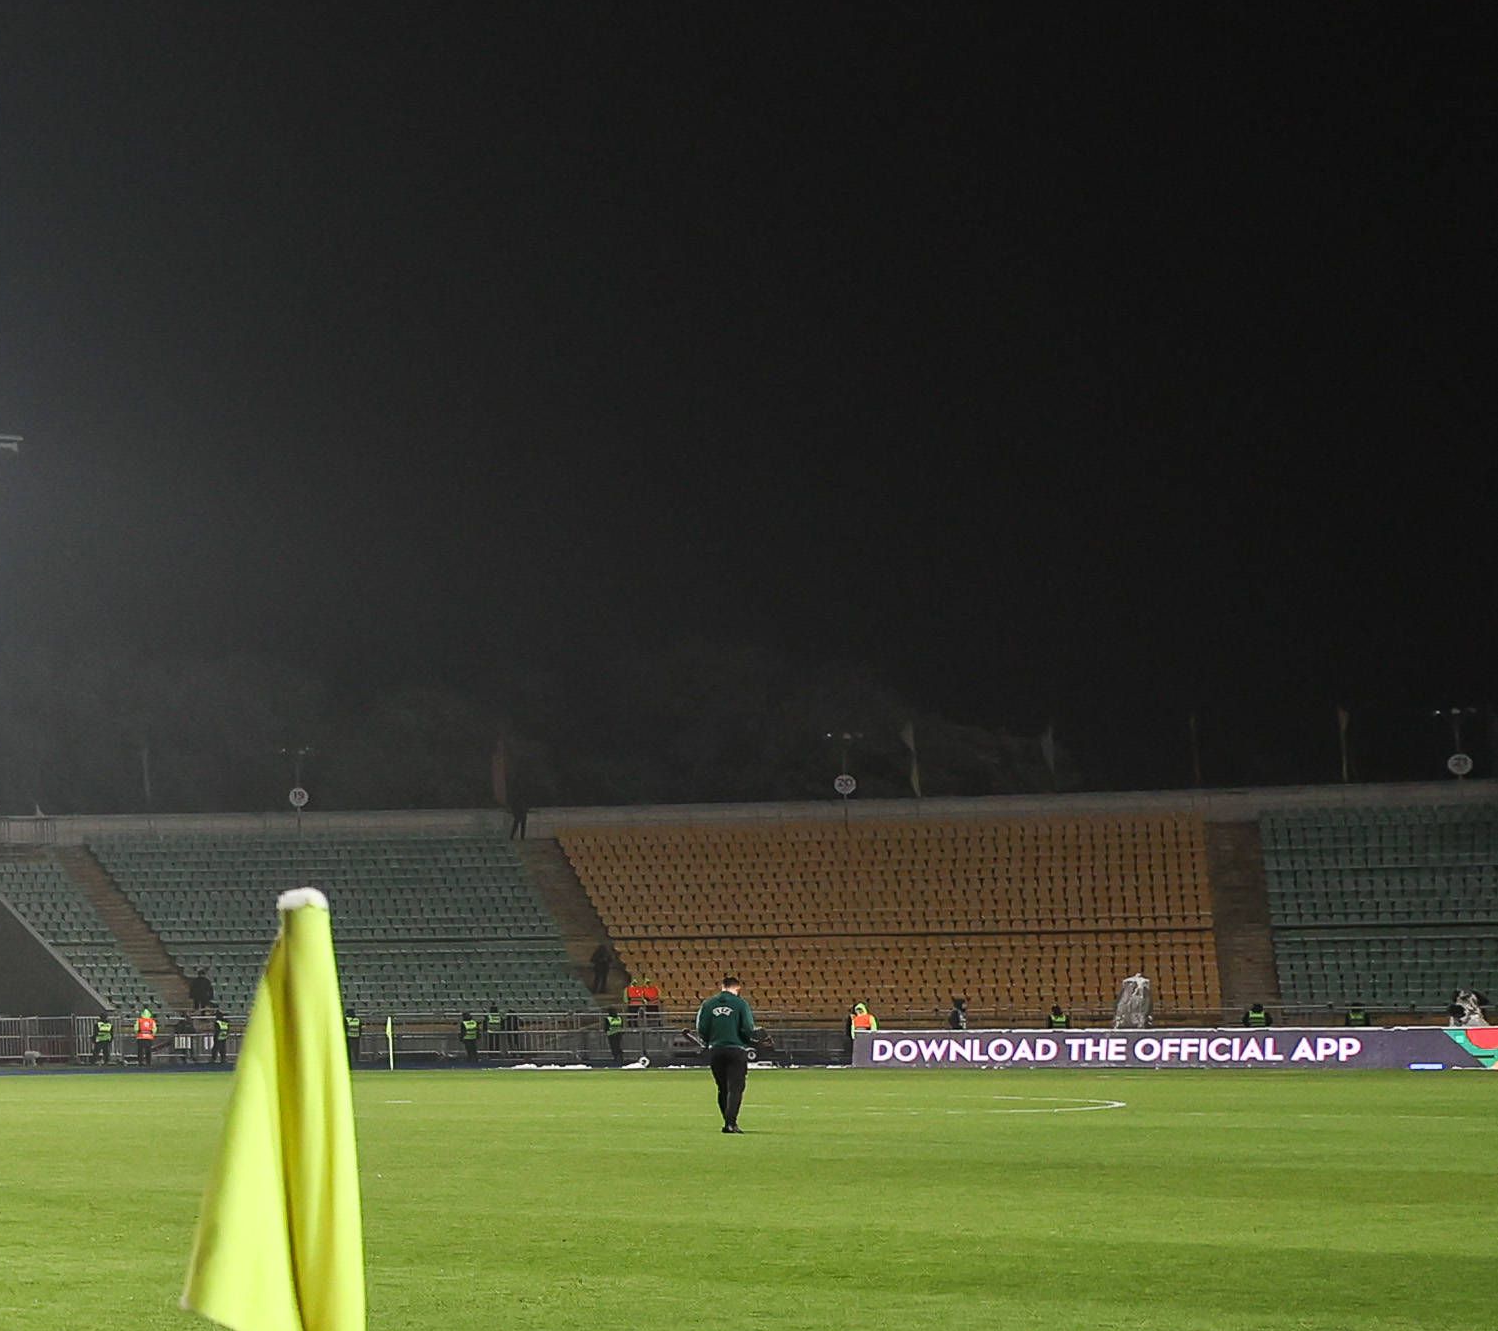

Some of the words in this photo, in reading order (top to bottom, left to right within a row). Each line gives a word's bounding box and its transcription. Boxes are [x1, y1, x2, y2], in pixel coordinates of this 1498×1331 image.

[872, 1037, 1058, 1062] DOWNLOAD
[1064, 1038, 1128, 1061] THE
[1134, 1037, 1284, 1062] OFFICIAL
[1291, 1037, 1362, 1062] APP
